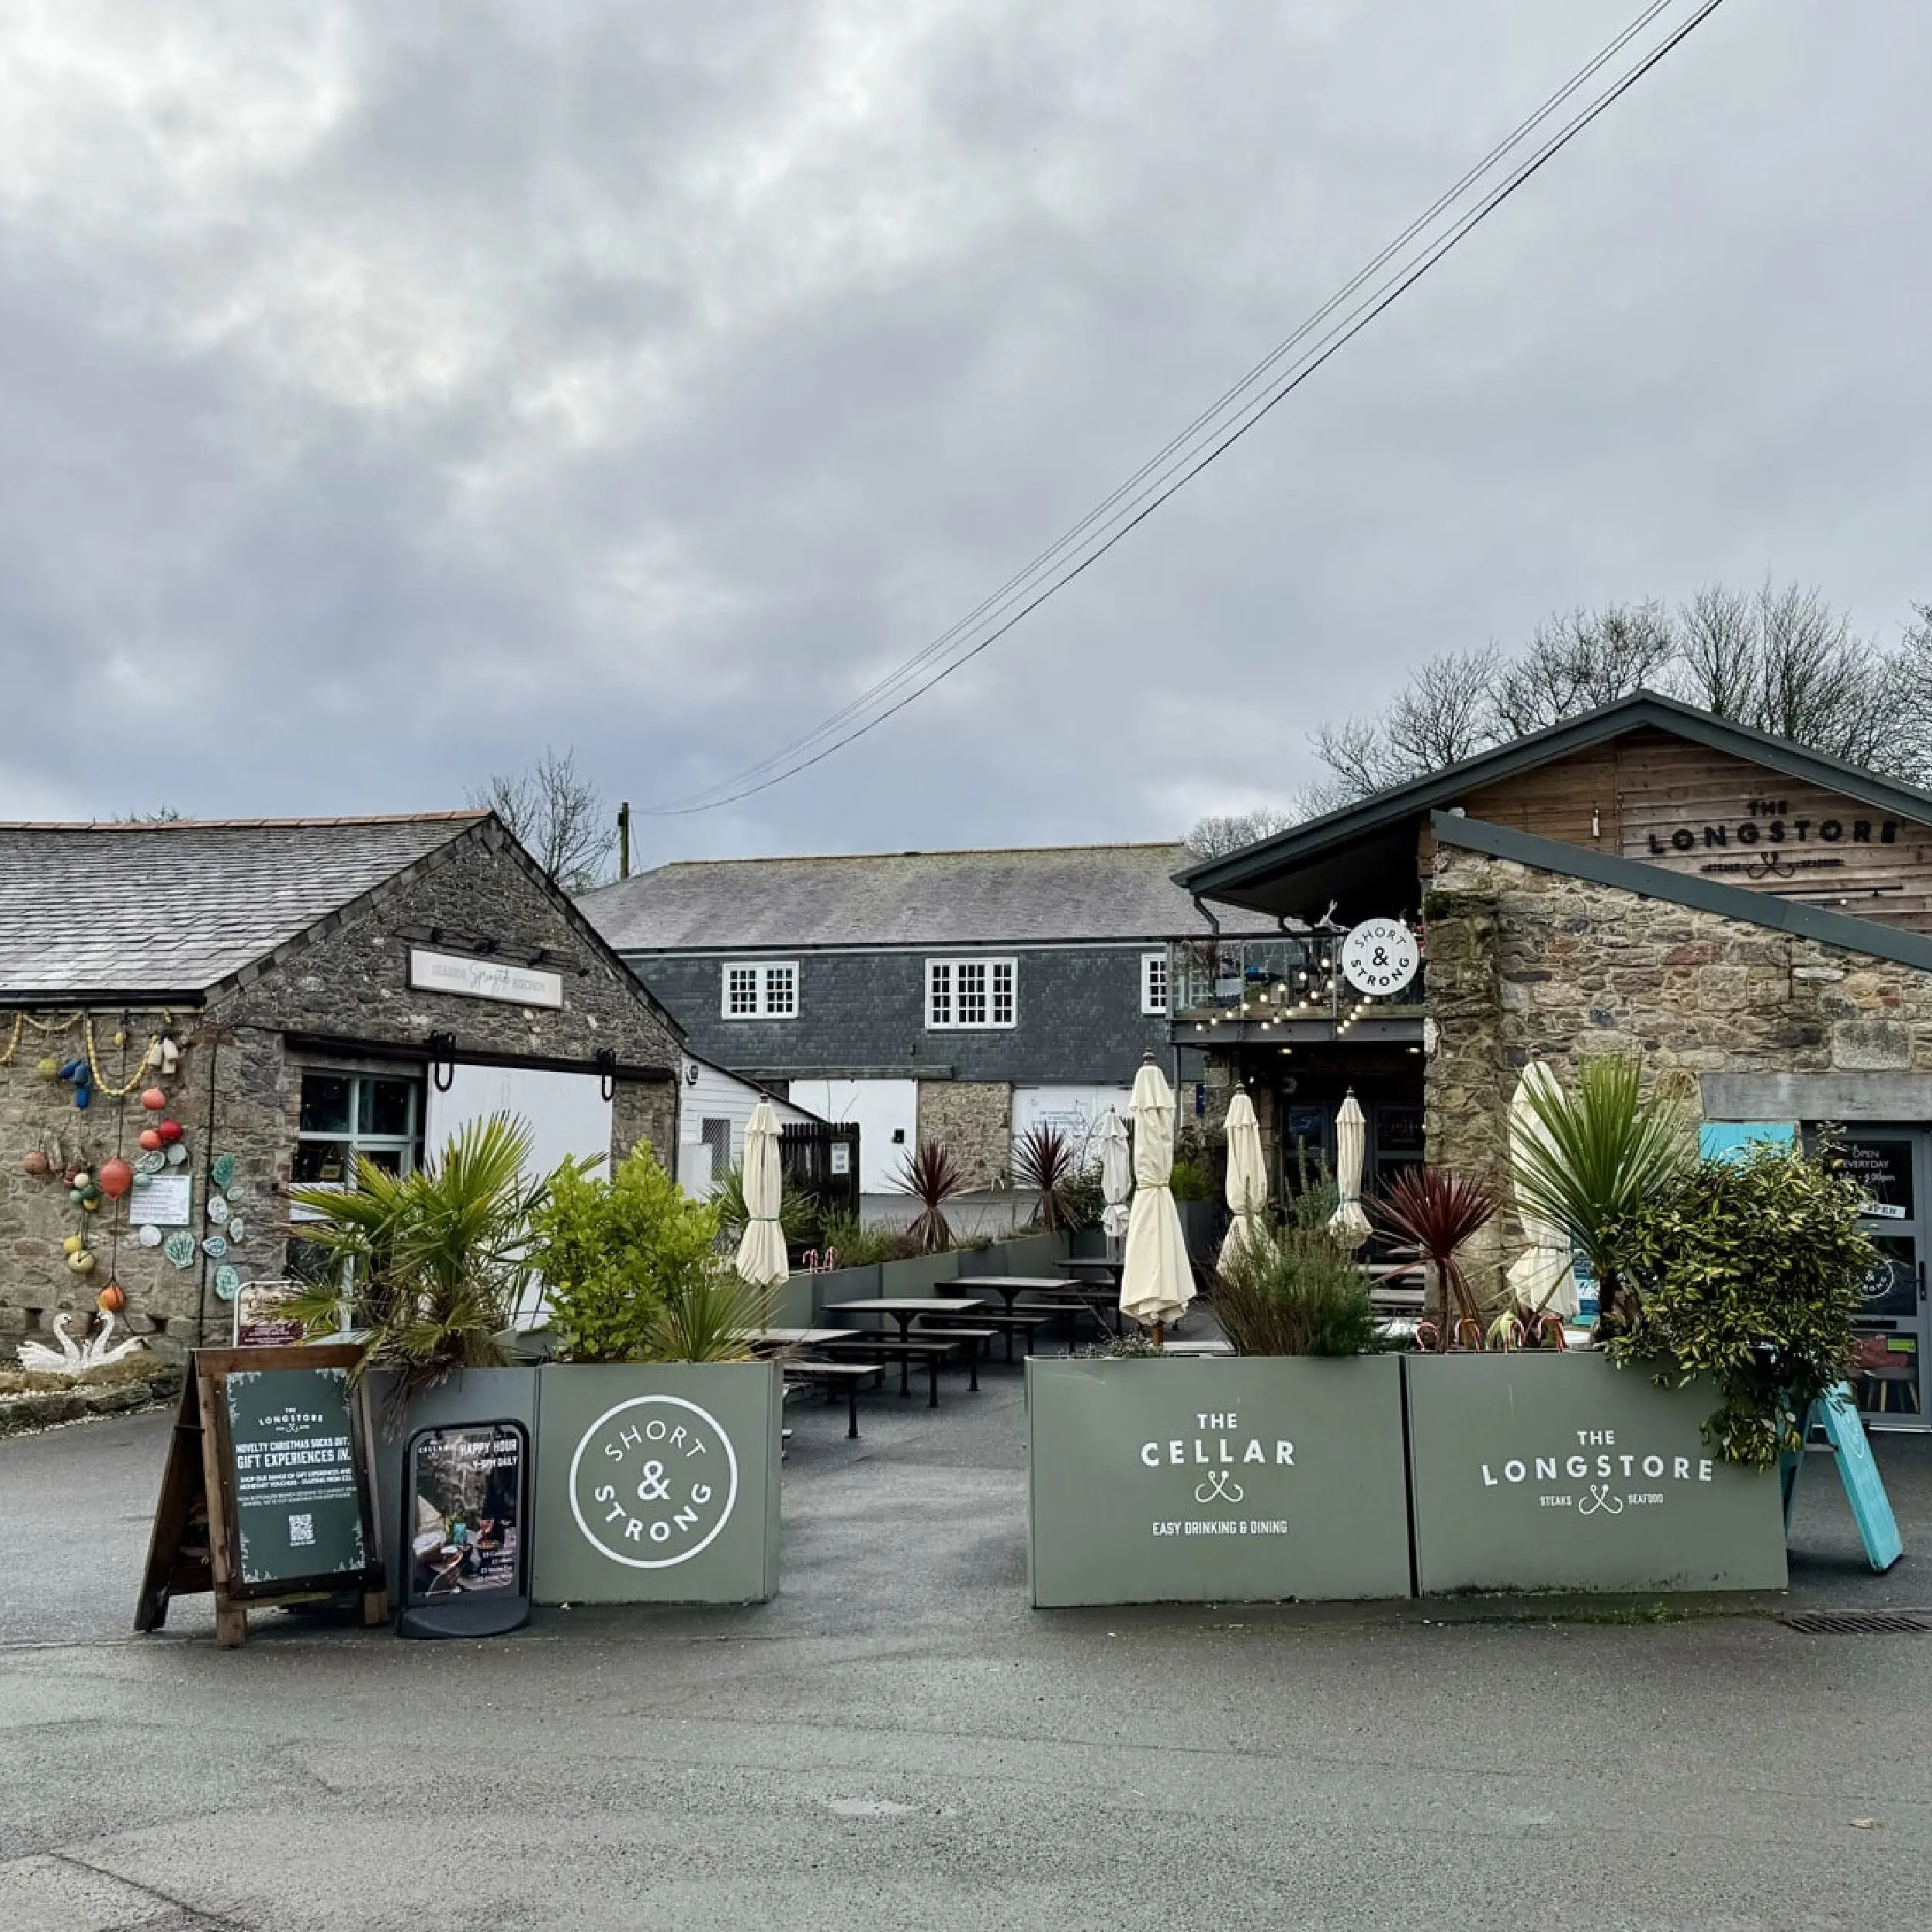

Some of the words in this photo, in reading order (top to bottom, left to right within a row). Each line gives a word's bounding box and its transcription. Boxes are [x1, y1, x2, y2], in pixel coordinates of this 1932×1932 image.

[1748, 801, 1787, 815] THE
[1648, 820, 1898, 854] LONGSTORE
[1354, 927, 1406, 948] SHORT
[1373, 946, 1389, 965] &
[1351, 958, 1409, 986] STRONG
[258, 1413, 323, 1426] LONGSTORE
[1197, 1413, 1237, 1430] THE
[493, 1438, 517, 1452] HOUR
[604, 1420, 706, 1462] SHORT
[1577, 1430, 1615, 1446] THE
[237, 1454, 262, 1468] GIFT
[264, 1450, 335, 1467] EXPERIENCES
[1141, 1438, 1294, 1467] CELLAR
[1481, 1454, 1714, 1486] LONGSTORE
[637, 1460, 672, 1500] &
[1539, 1495, 1572, 1506] STEAKS
[1628, 1493, 1664, 1504] SEAFOOD
[594, 1484, 712, 1542] STRONG
[1152, 1521, 1181, 1536] EASY
[1185, 1521, 1236, 1535] DRINKING
[1240, 1521, 1247, 1534] &
[1250, 1520, 1287, 1534] DINING
